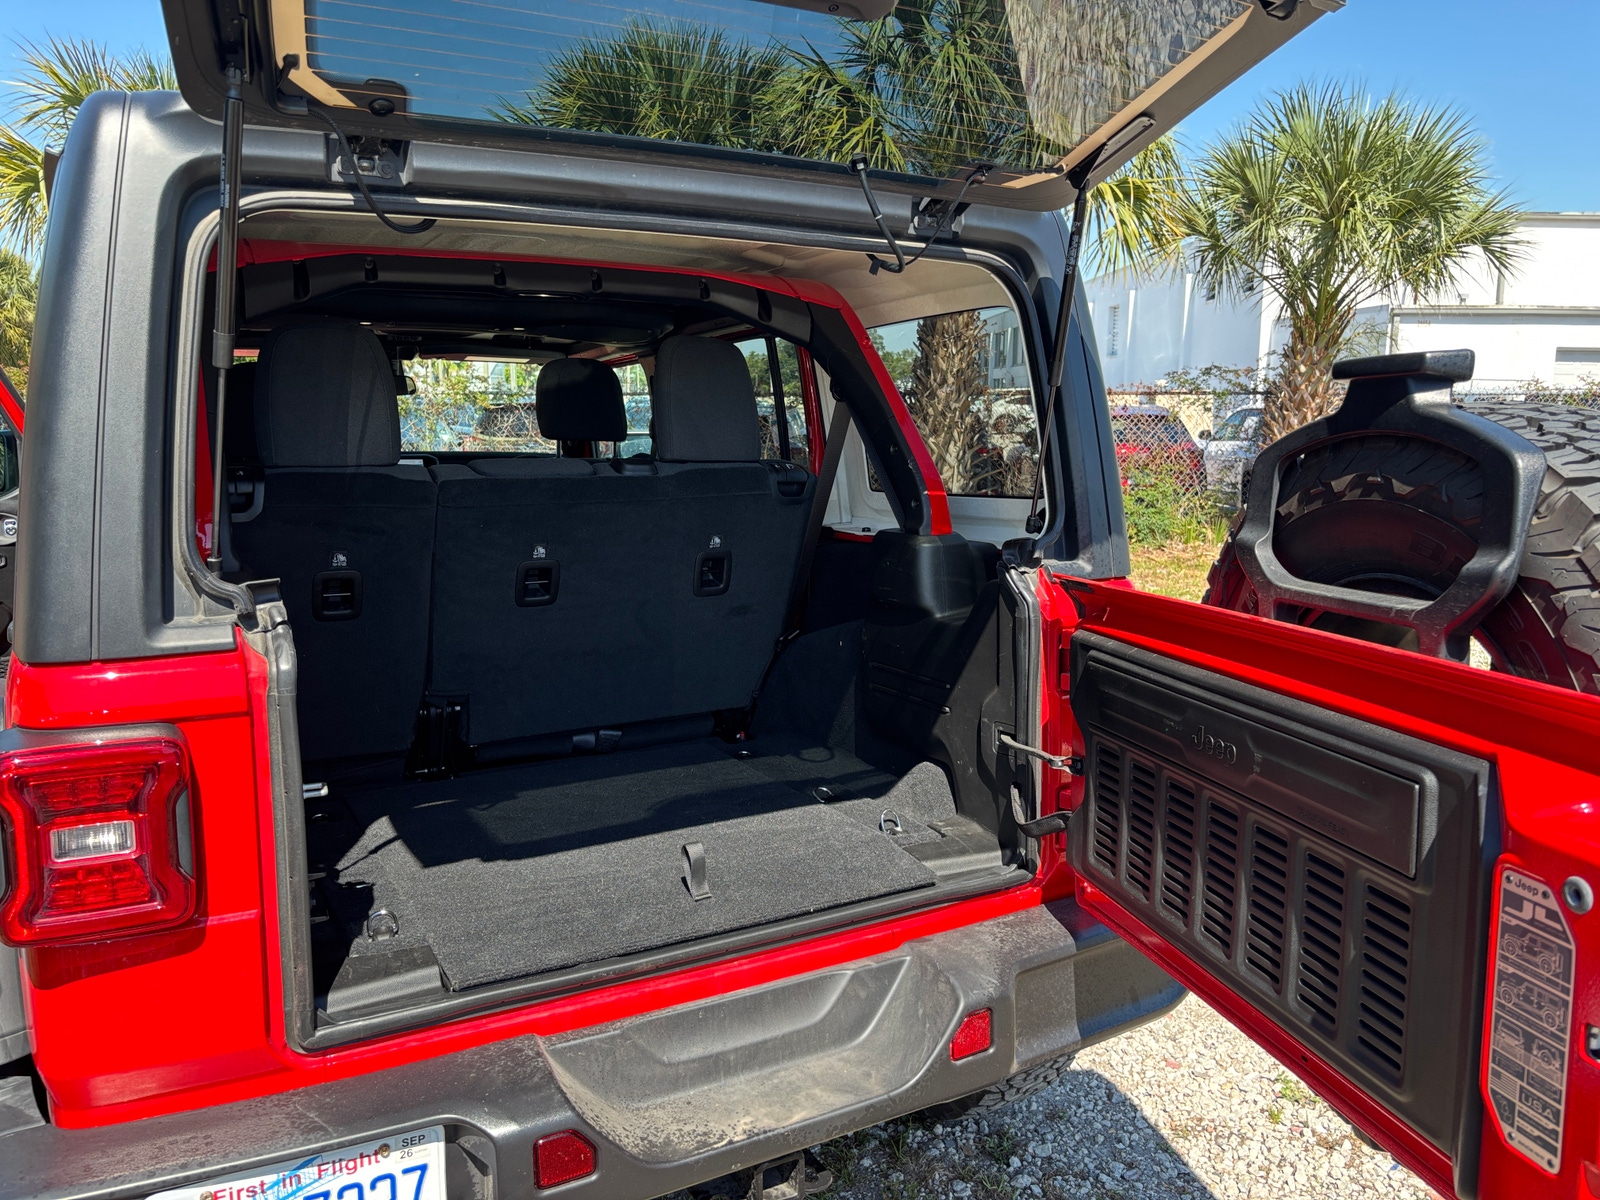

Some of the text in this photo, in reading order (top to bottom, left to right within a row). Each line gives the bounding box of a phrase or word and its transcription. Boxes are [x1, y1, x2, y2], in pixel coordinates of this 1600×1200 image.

[1191, 724, 1237, 768] Jeep
[1514, 878, 1539, 897] Jeep
[1521, 1093, 1556, 1122] USA
[401, 1134, 426, 1148] SEP
[399, 1148, 414, 1160] 26
[213, 1179, 267, 1200] First
[281, 1173, 302, 1189] in
[317, 1149, 381, 1180] Flight
